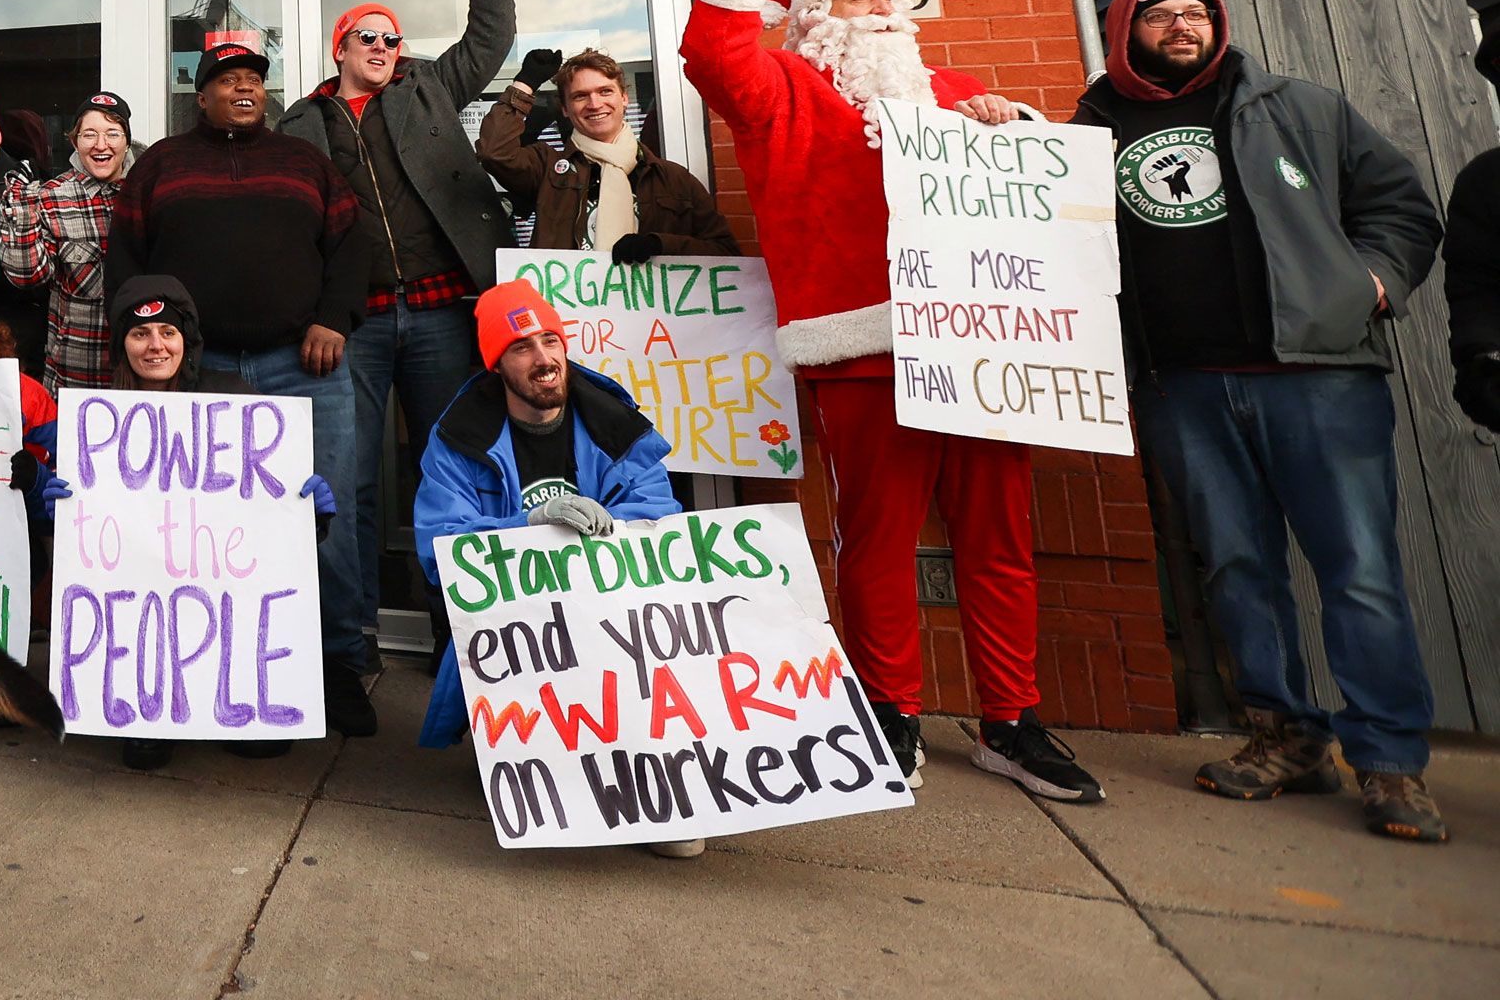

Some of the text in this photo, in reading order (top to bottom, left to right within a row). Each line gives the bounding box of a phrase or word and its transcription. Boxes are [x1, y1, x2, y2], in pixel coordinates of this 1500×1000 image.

[1127, 132, 1216, 163] STARBUC
[920, 173, 1053, 222] RIGHTS
[1120, 178, 1187, 220] WORKERS
[515, 258, 746, 316] ORGANIZE
[897, 248, 1046, 292] ARE MORE
[562, 319, 626, 354] FOR
[644, 319, 678, 359] A
[896, 301, 1079, 342] IMPORTANT
[598, 351, 782, 410] HTER
[898, 356, 1125, 426] THAN COFFEE
[77, 396, 286, 500] POWER
[639, 405, 759, 467] URE
[73, 496, 258, 579] to the
[447, 515, 790, 613] Starbucks,
[60, 584, 305, 728] PEOPLE
[468, 595, 750, 700] end your
[540, 652, 797, 752] WAR
[490, 757, 569, 840] on
